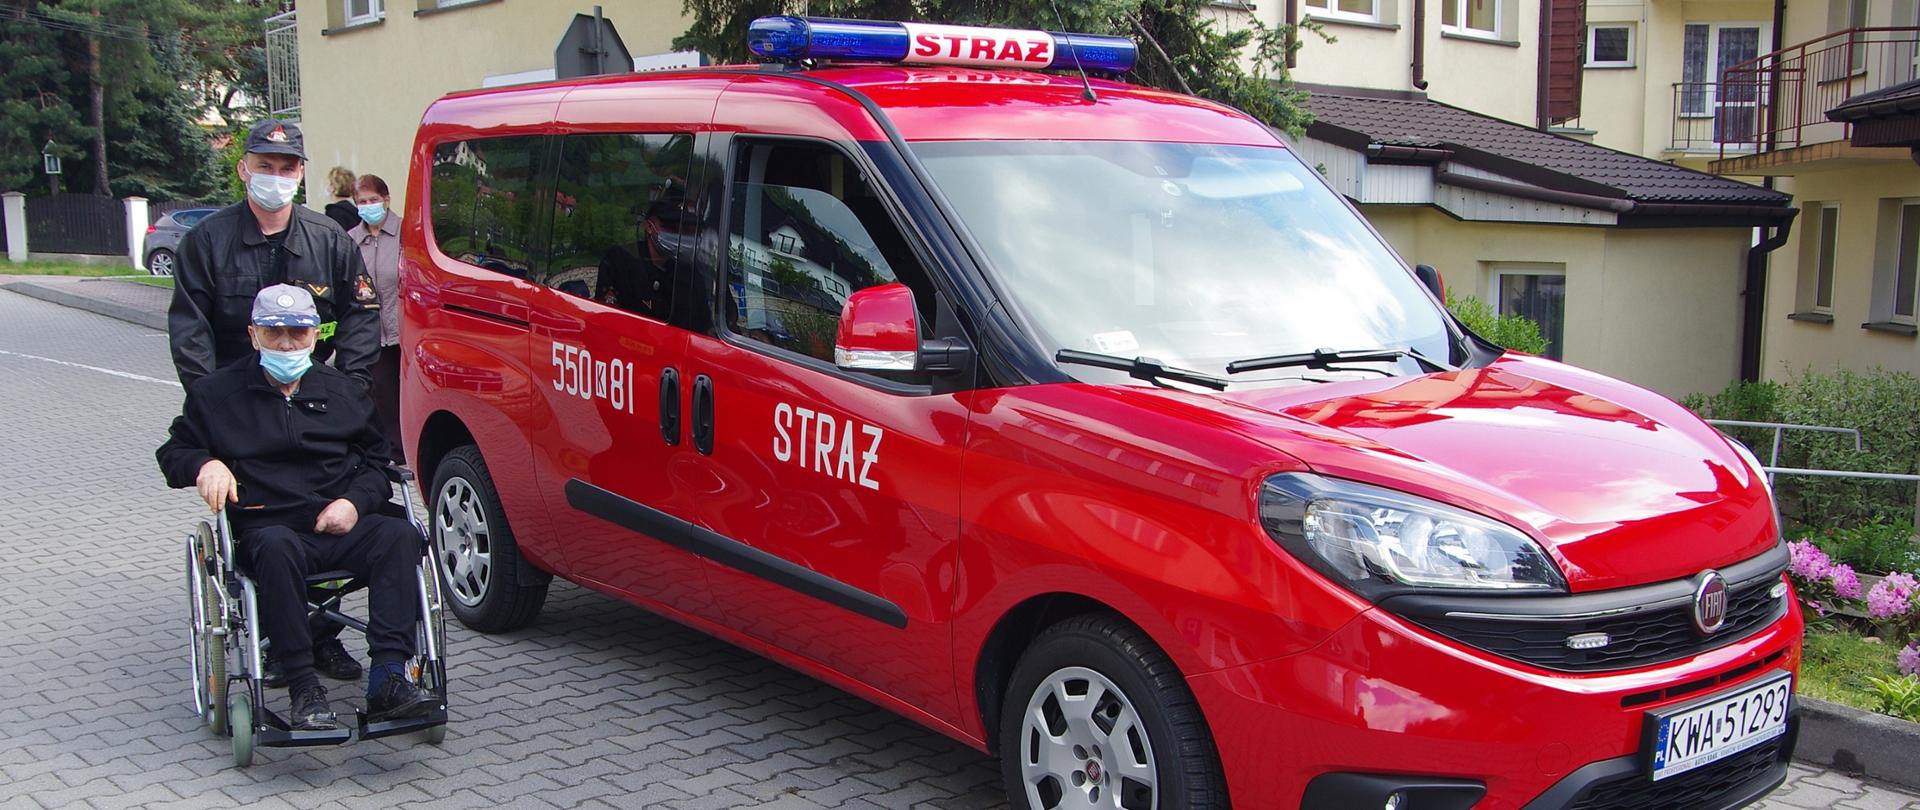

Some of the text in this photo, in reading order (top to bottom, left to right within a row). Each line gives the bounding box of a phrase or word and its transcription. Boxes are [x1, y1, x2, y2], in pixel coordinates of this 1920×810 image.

[1705, 590, 1723, 620] FIAT
[1722, 684, 1787, 743] 51293
[1655, 750, 1665, 763] PL
